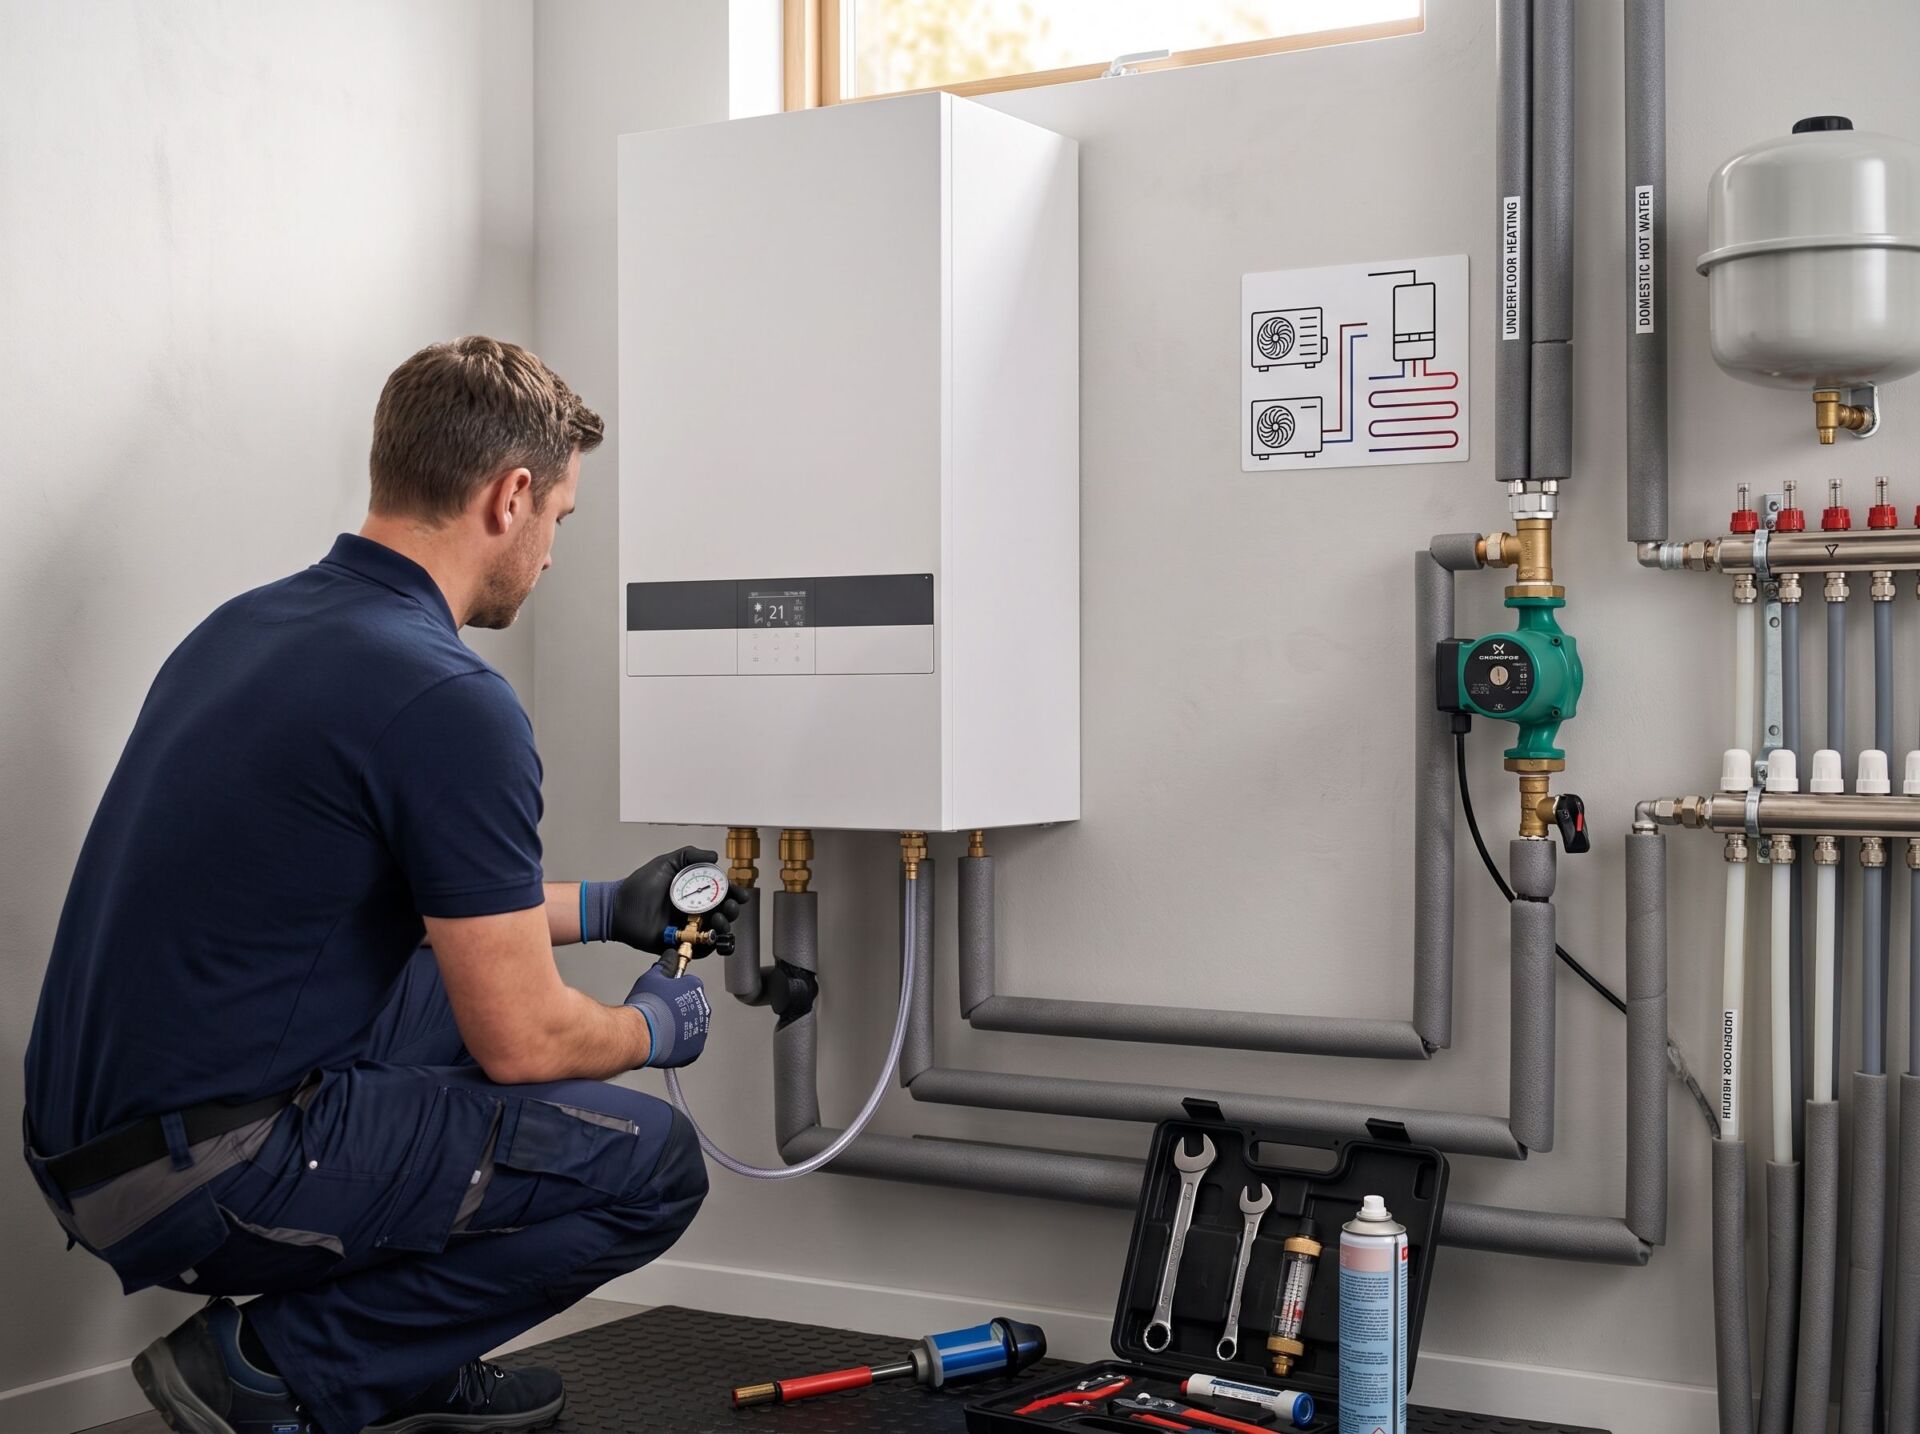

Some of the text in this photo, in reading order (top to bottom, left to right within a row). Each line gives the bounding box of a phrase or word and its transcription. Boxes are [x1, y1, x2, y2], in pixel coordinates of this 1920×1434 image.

[1506, 202, 1517, 335] UNDERFLOOR HEATING
[1638, 191, 1650, 326] DOMESTIC HOT WATER
[769, 604, 784, 620] 21
